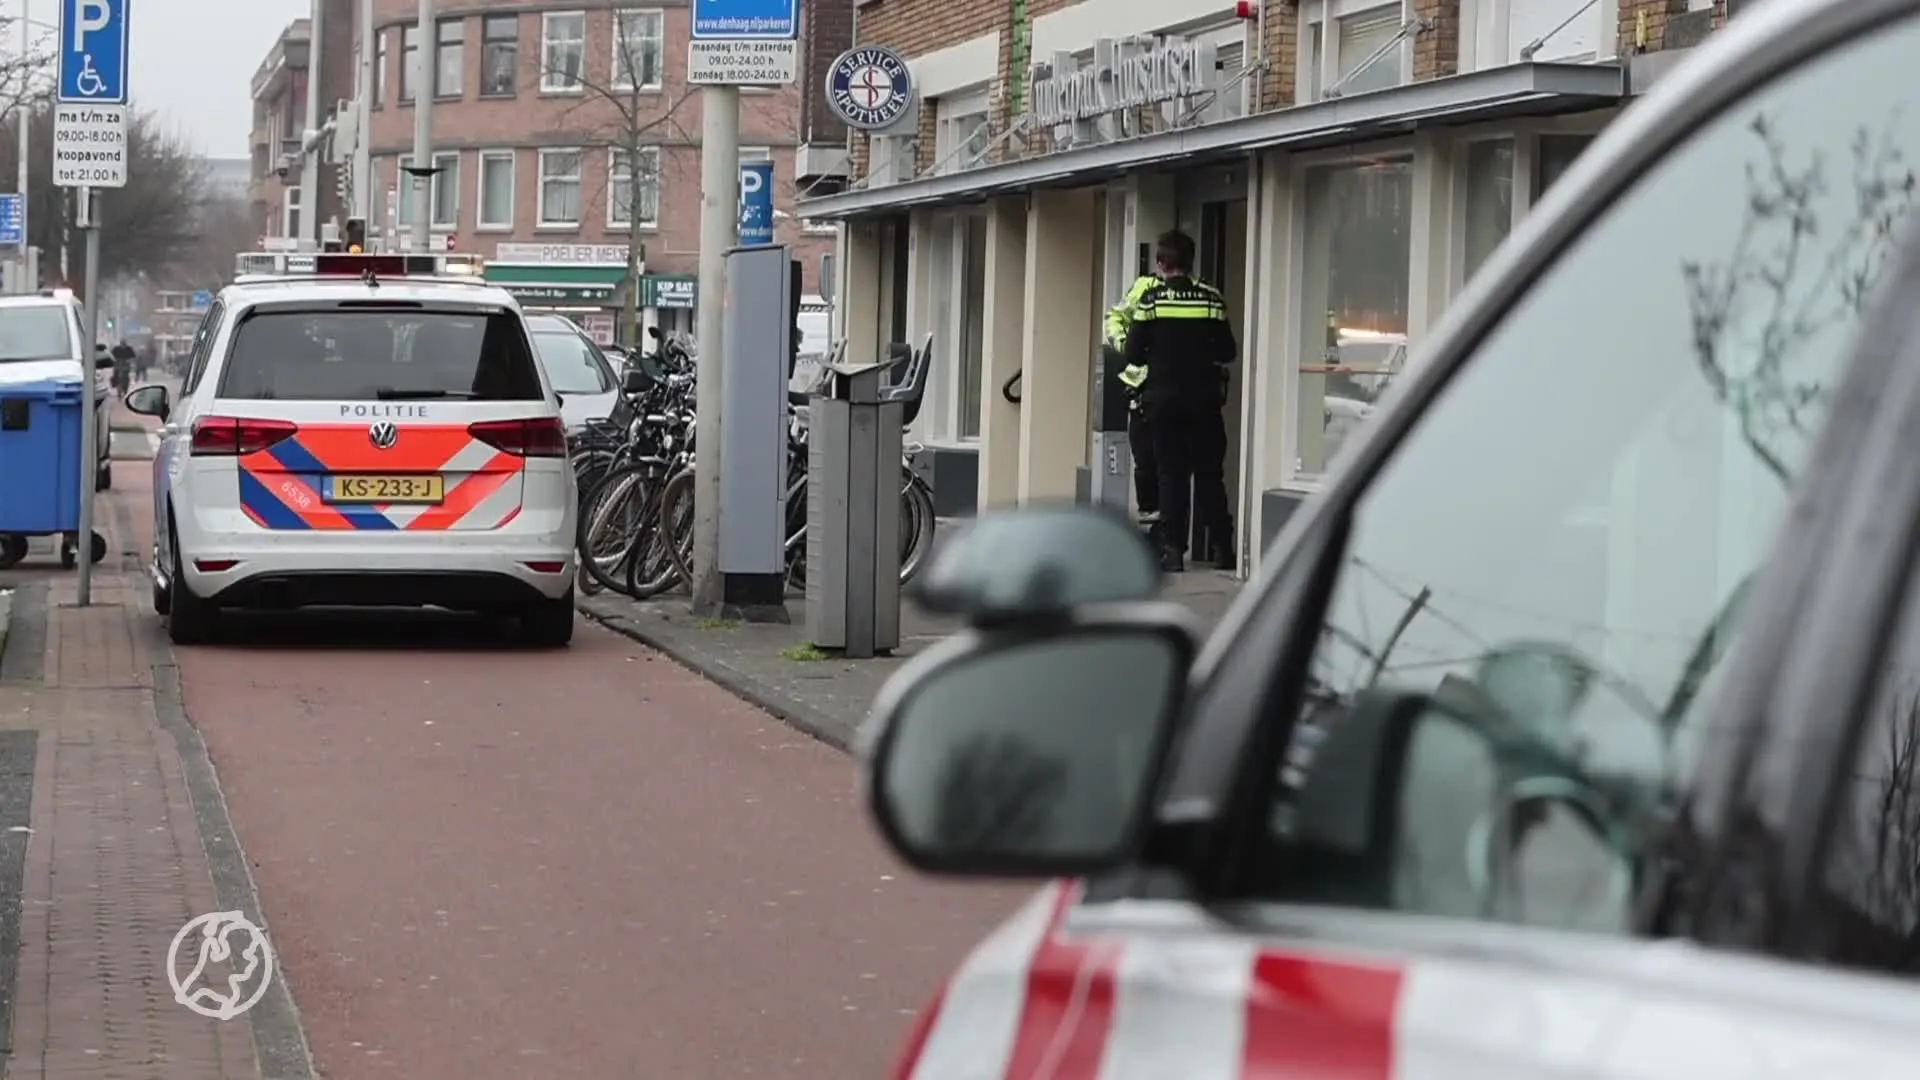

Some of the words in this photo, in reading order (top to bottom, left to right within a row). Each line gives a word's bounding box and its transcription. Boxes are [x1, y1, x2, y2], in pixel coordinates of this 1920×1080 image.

[74, 0, 110, 51] P
[692, 43, 731, 53] maandag
[734, 43, 751, 52] t/m
[754, 43, 793, 54] zaterdag
[708, 56, 765, 65] 09.00-24.00
[768, 56, 774, 65] h
[839, 51, 902, 78] SERVICE
[693, 70, 723, 80] zondag
[727, 70, 780, 79] 18.00-24.00
[783, 71, 789, 79] h
[834, 88, 906, 124] APOTHEEK
[59, 112, 77, 123] ma
[81, 110, 103, 123] t/m
[106, 112, 120, 123] za
[56, 130, 116, 142] 09.00-18.00
[116, 131, 122, 142] h
[57, 149, 121, 162] koopavond
[59, 170, 75, 180] tot
[78, 170, 109, 181] 21.00
[112, 170, 118, 180] h
[742, 170, 762, 205] P
[657, 281, 674, 292] KIP
[340, 405, 428, 417] POLITIE
[341, 479, 433, 497] KS-233-J
